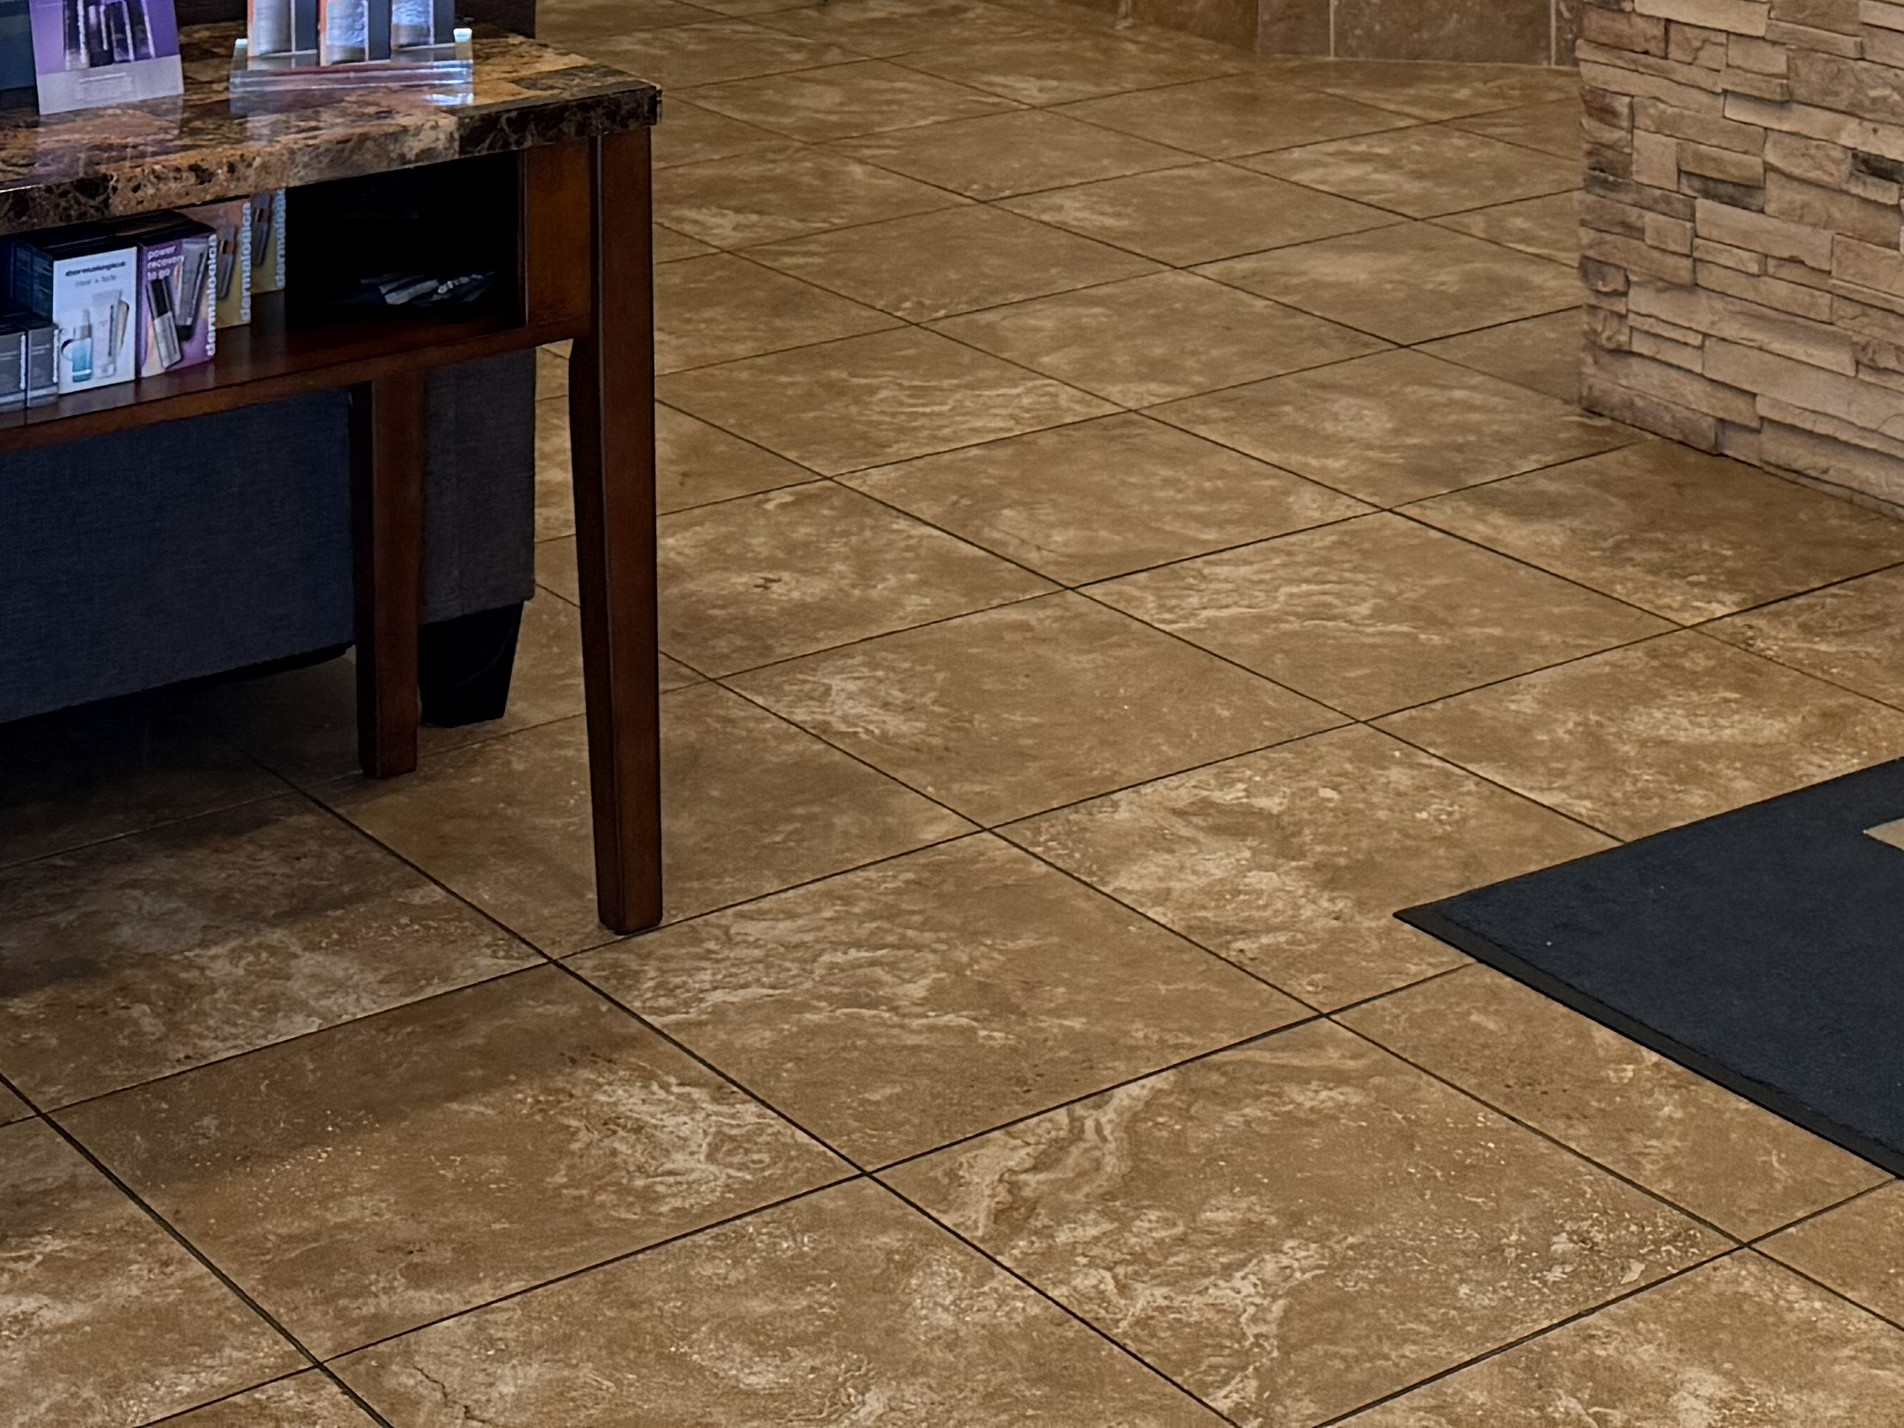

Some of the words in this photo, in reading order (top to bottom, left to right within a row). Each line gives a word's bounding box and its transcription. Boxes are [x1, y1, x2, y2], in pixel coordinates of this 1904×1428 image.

[147, 245, 177, 260] power
[147, 255, 184, 270] recovery
[206, 234, 217, 357] dermalogica
